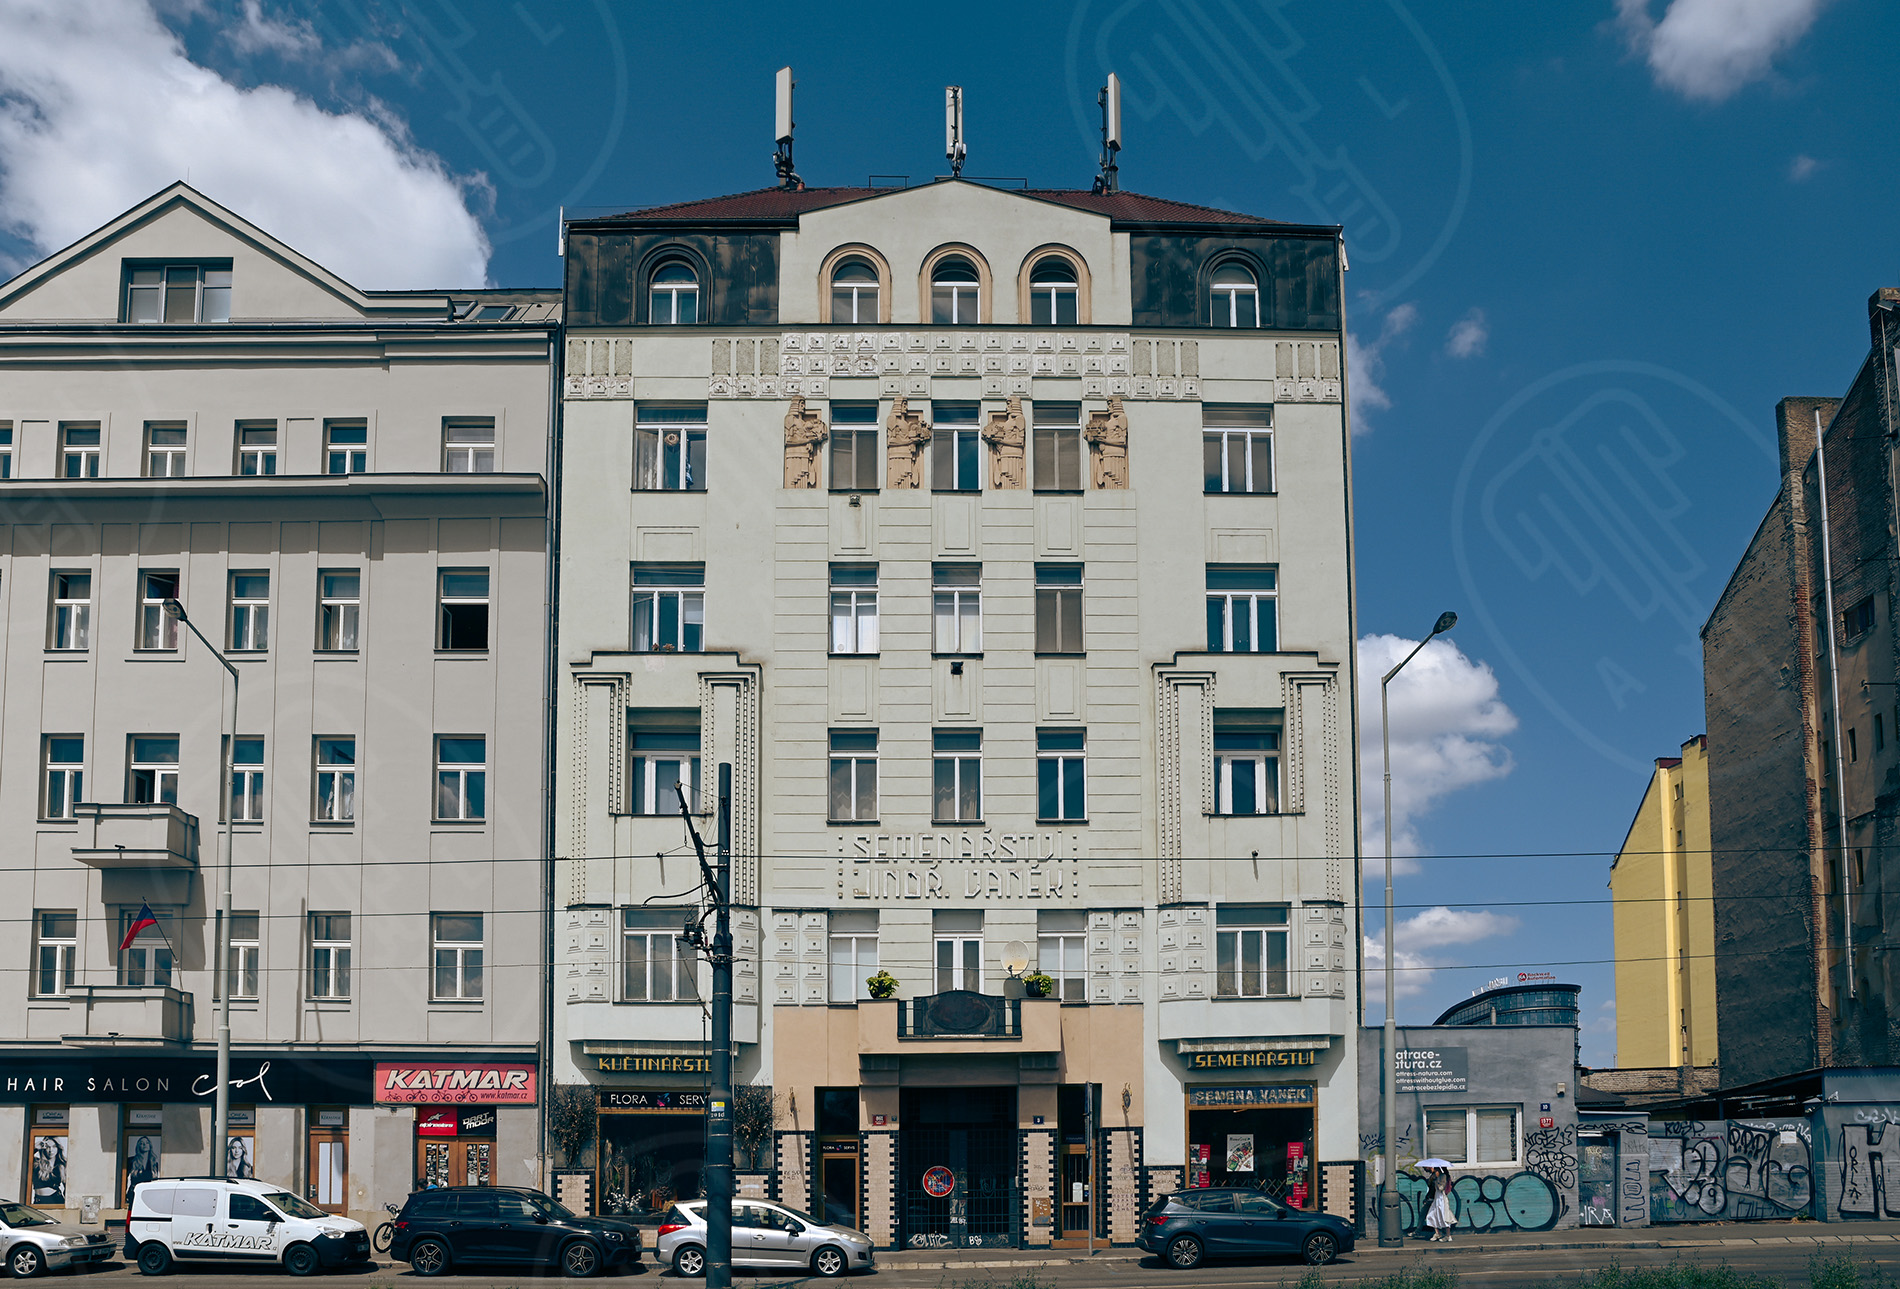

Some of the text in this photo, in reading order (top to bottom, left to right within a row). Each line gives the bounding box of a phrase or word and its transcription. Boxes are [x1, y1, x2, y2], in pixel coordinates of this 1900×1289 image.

[1395, 1049, 1440, 1060] atrace-
[1395, 1060, 1442, 1069] atura.cz
[7, 1077, 64, 1091] HAIR
[87, 1077, 169, 1091] SALON
[384, 1069, 529, 1090] KATMAR
[480, 1090, 528, 1100] www.katmar.cz
[610, 1094, 711, 1105] FLORA SERV
[1195, 1090, 1254, 1101] SEMENA
[183, 1232, 272, 1250] KATMAR
